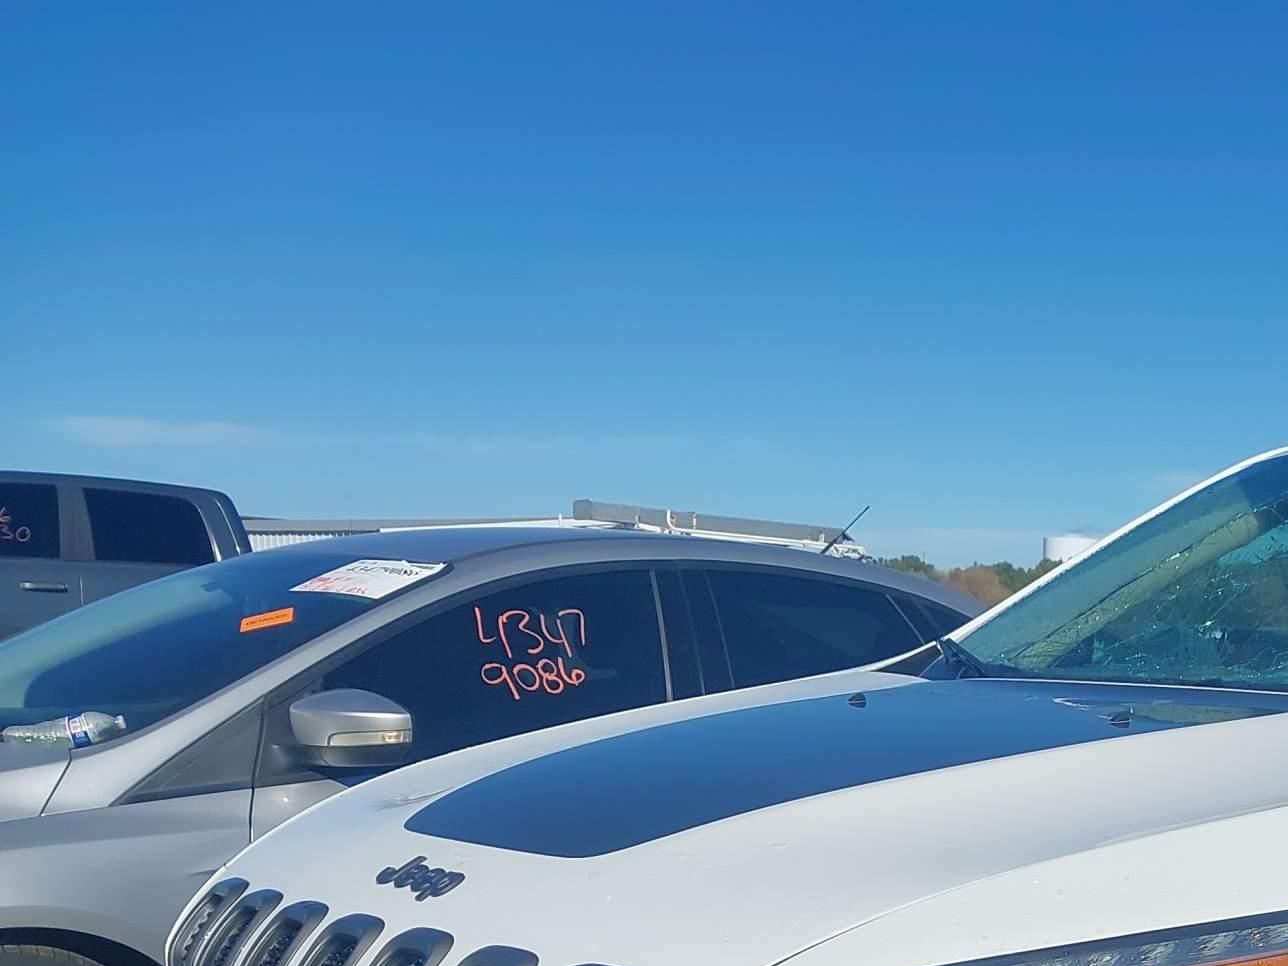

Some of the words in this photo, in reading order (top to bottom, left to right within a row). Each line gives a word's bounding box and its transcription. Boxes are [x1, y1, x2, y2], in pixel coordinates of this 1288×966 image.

[474, 606, 586, 658] 4347
[481, 656, 586, 701] 9086
[375, 855, 466, 903] Jeep
